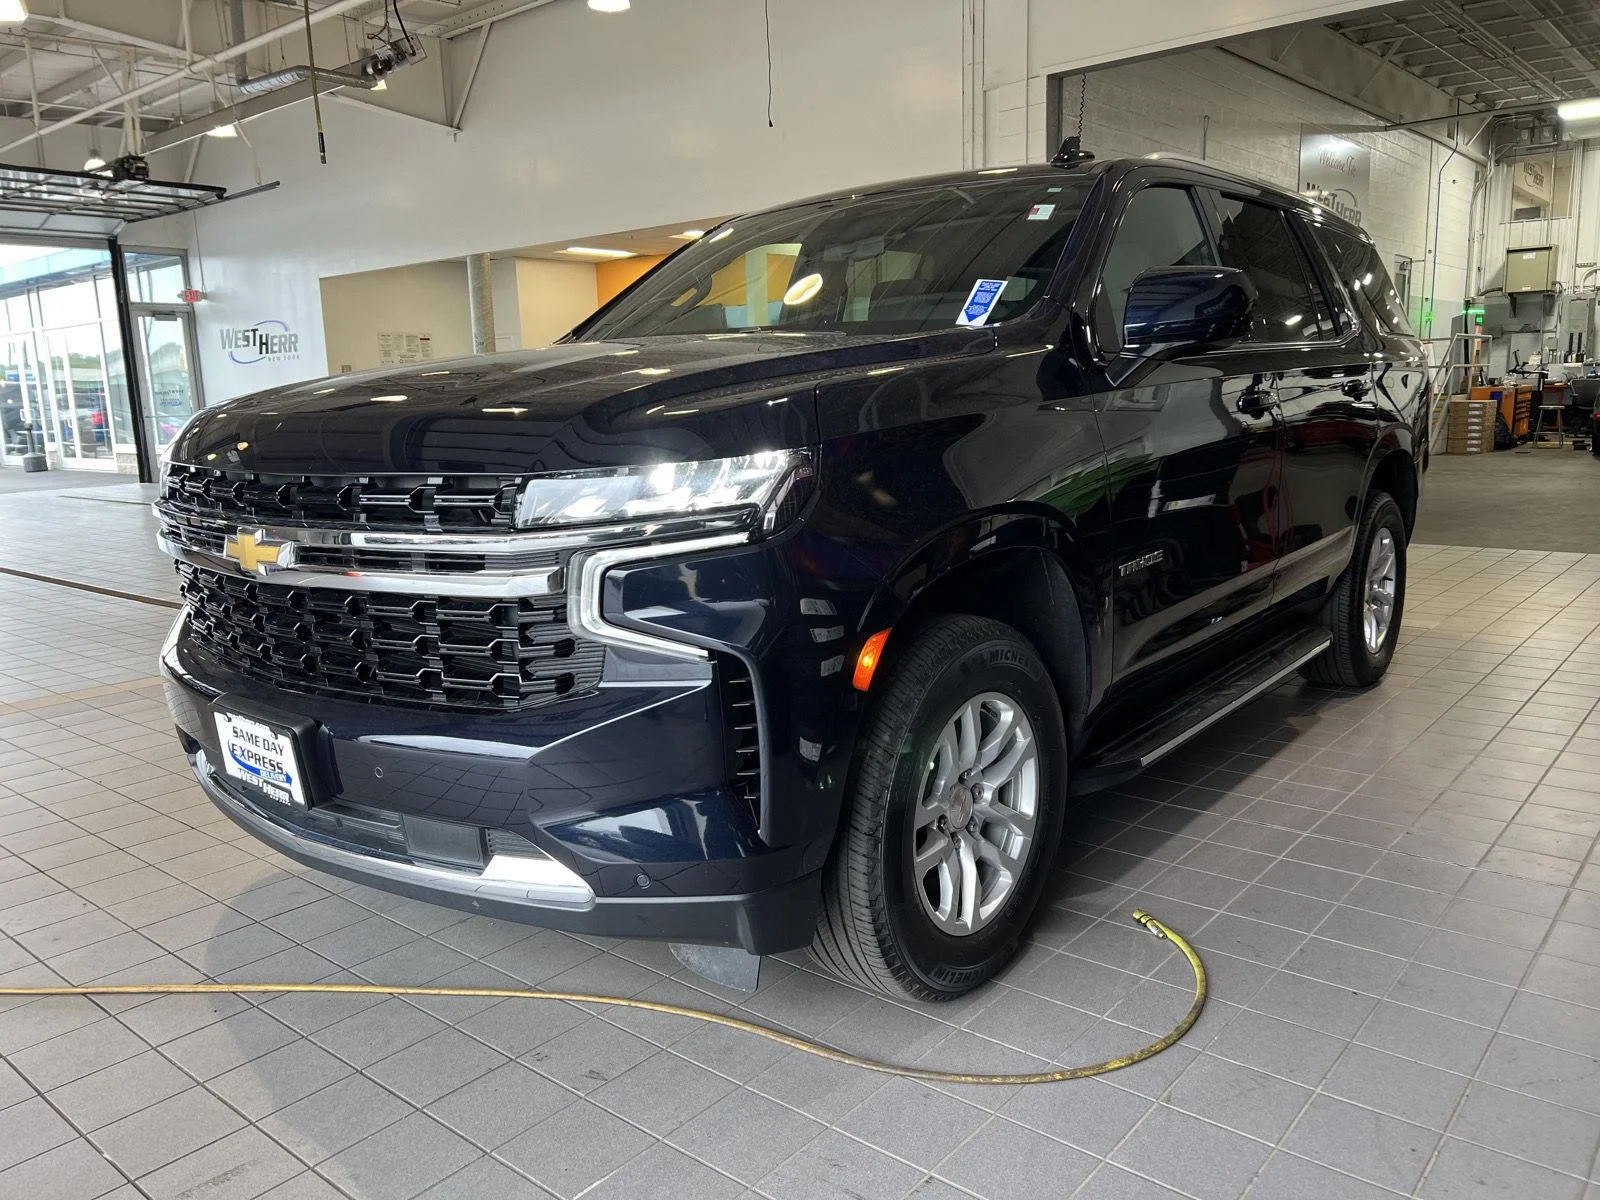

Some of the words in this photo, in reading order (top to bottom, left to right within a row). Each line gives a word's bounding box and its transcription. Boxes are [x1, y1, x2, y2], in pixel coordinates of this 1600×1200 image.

[1319, 151, 1345, 173] Welcome
[220, 328, 258, 349] WEST
[259, 333, 298, 354] HERR
[232, 725, 260, 747] SAME
[263, 738, 284, 756] DAY
[231, 743, 284, 774] EXPRESS
[238, 768, 263, 787] WEST
[260, 769, 287, 782] DELIVERY
